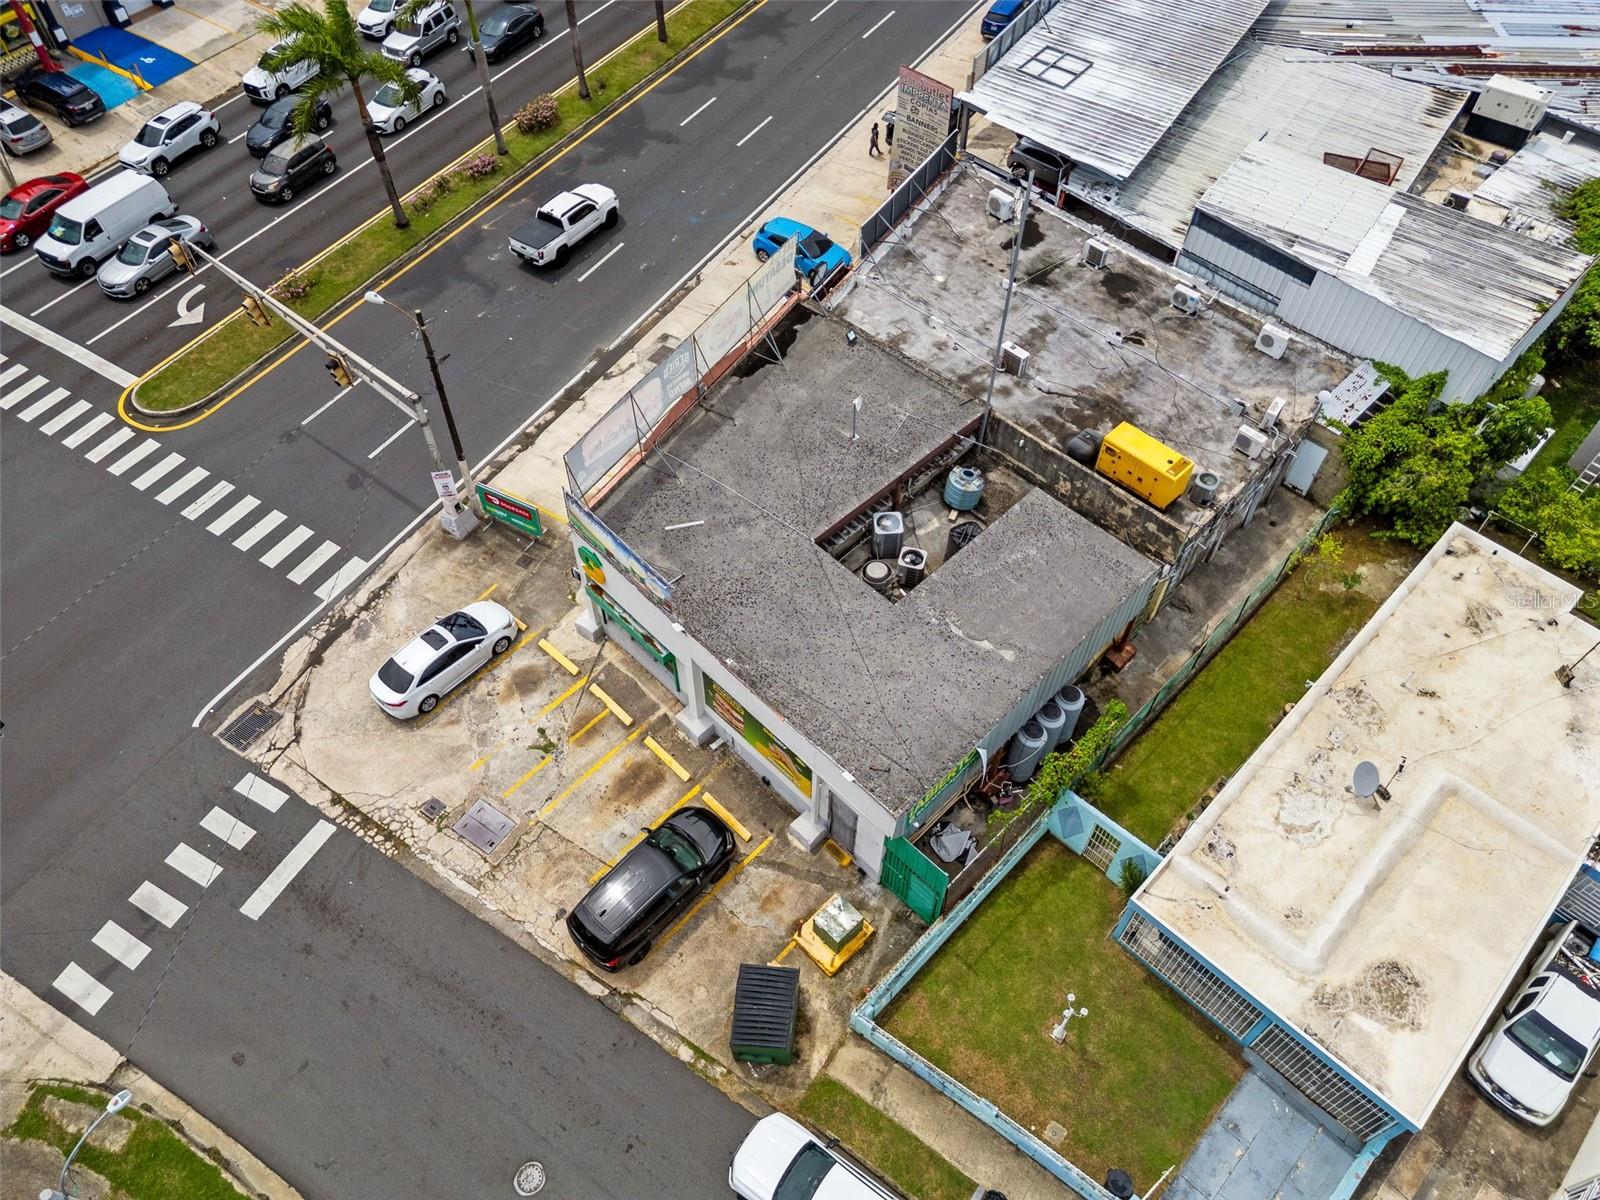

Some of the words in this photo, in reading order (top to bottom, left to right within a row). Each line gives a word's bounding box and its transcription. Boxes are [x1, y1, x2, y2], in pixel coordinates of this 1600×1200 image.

[900, 83, 949, 112] IMPRENTA
[909, 97, 938, 116] COPIAS
[906, 115, 939, 134] BANNERS
